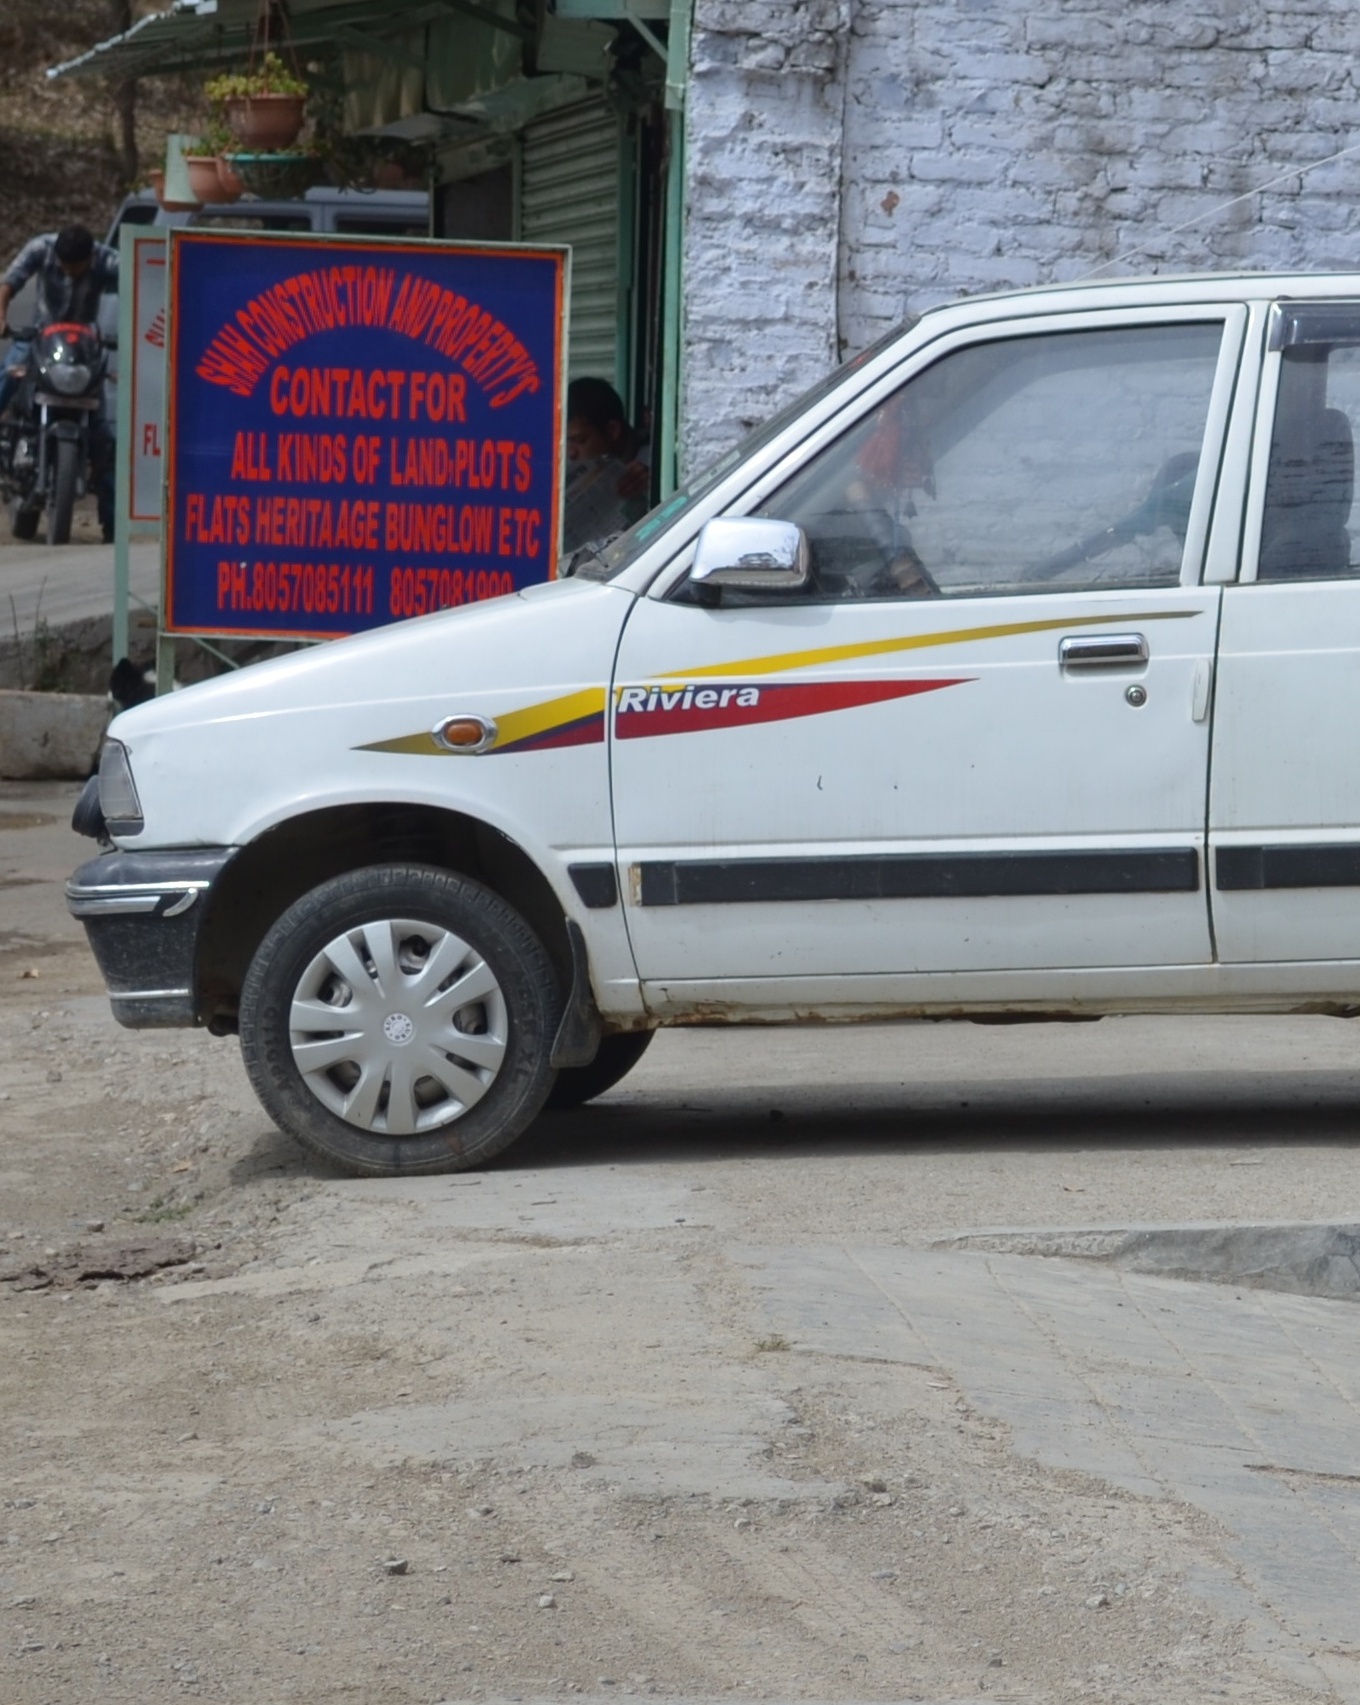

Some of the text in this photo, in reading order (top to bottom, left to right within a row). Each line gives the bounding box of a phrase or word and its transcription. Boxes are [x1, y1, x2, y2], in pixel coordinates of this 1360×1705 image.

[235, 265, 396, 358] CONSTRUCTION
[388, 273, 441, 340] AND
[269, 365, 467, 423] CONTACT FOR
[231, 431, 272, 482] ALL
[277, 432, 348, 484] KINDS
[353, 434, 382, 485] OF
[185, 494, 542, 559] FLATS HERITAAGE BUNGLOW ETC
[617, 685, 760, 713] Riviera
